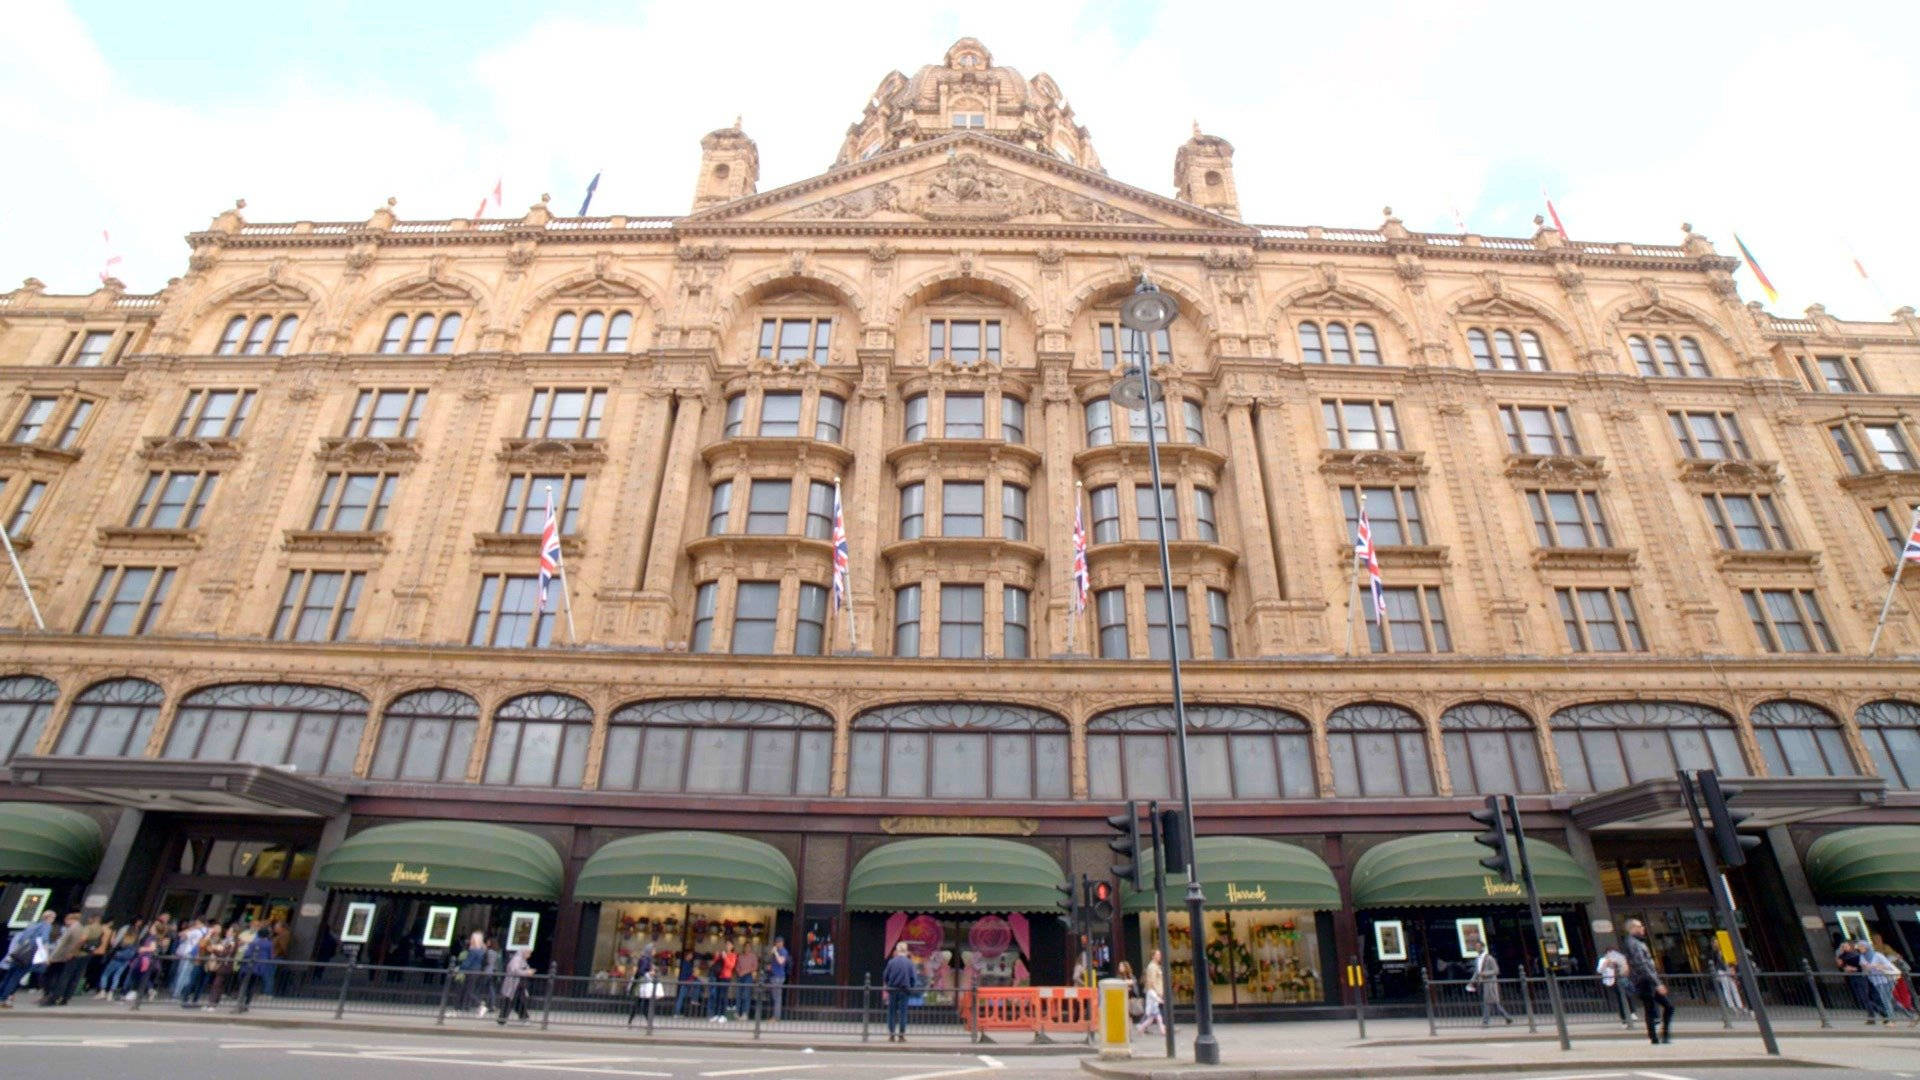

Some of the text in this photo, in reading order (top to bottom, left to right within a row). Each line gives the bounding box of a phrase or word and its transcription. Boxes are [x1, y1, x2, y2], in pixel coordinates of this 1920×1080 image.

[391, 863, 429, 885] Harrods
[648, 875, 687, 896] Harrods
[936, 883, 977, 903] Harrods
[1225, 883, 1266, 903] Harrods
[1482, 876, 1521, 896] Harrods
